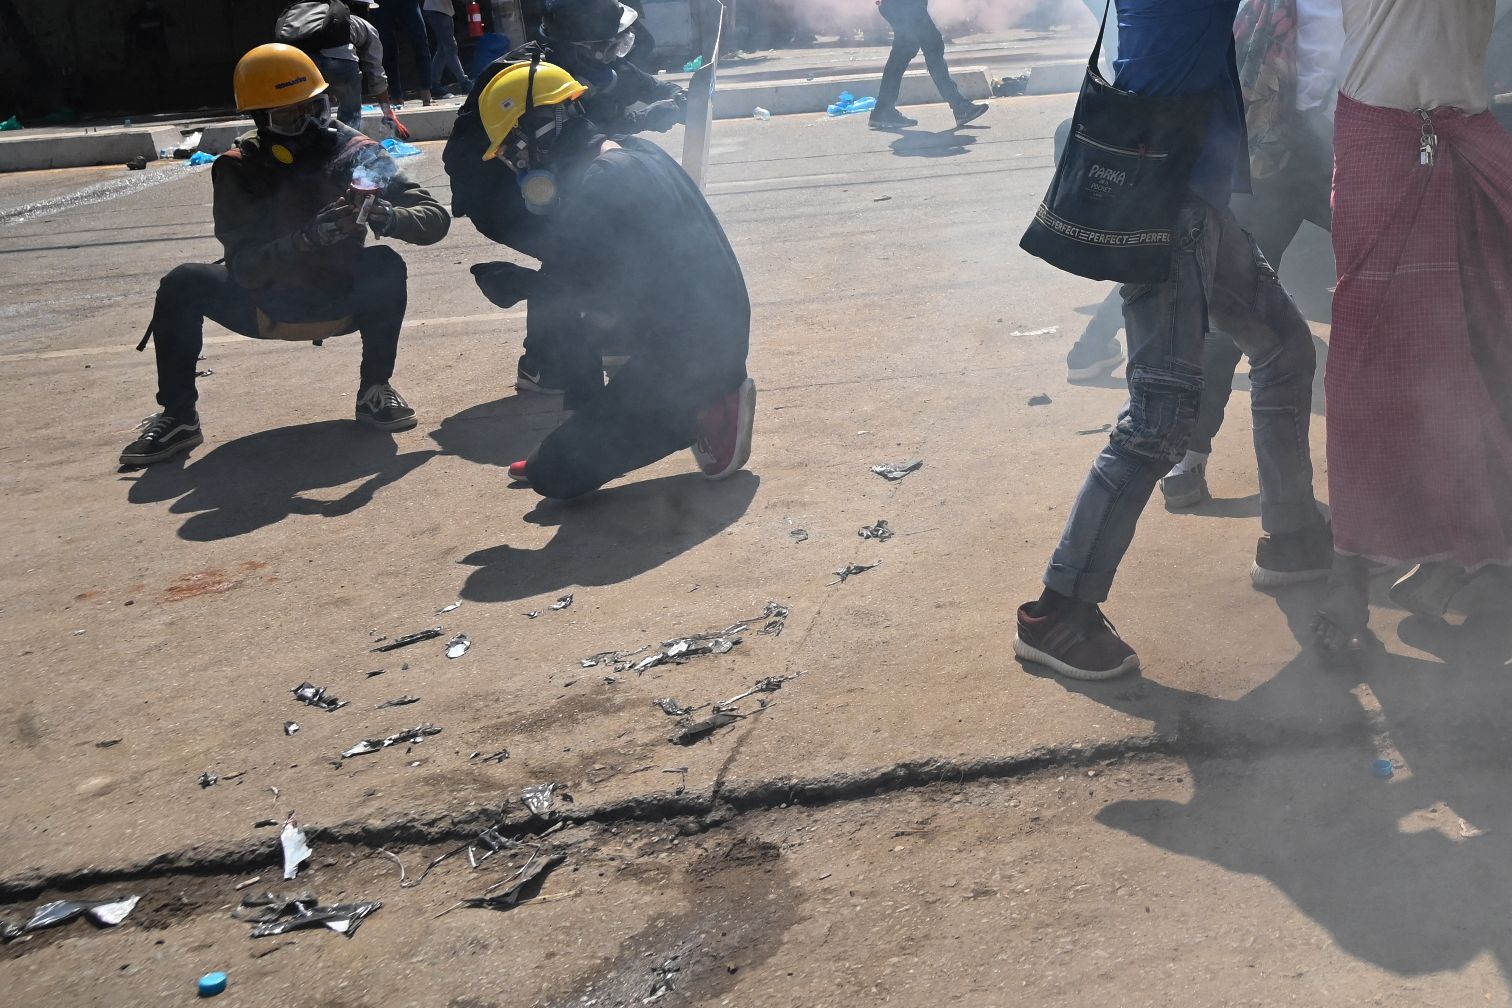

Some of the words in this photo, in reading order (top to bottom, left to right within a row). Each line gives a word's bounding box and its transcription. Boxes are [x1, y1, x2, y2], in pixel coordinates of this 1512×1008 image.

[1088, 164, 1126, 187] PARKA
[1090, 182, 1112, 193] POCKET
[1051, 219, 1080, 238] PERFECT
[1088, 232, 1129, 244] PERFECT
